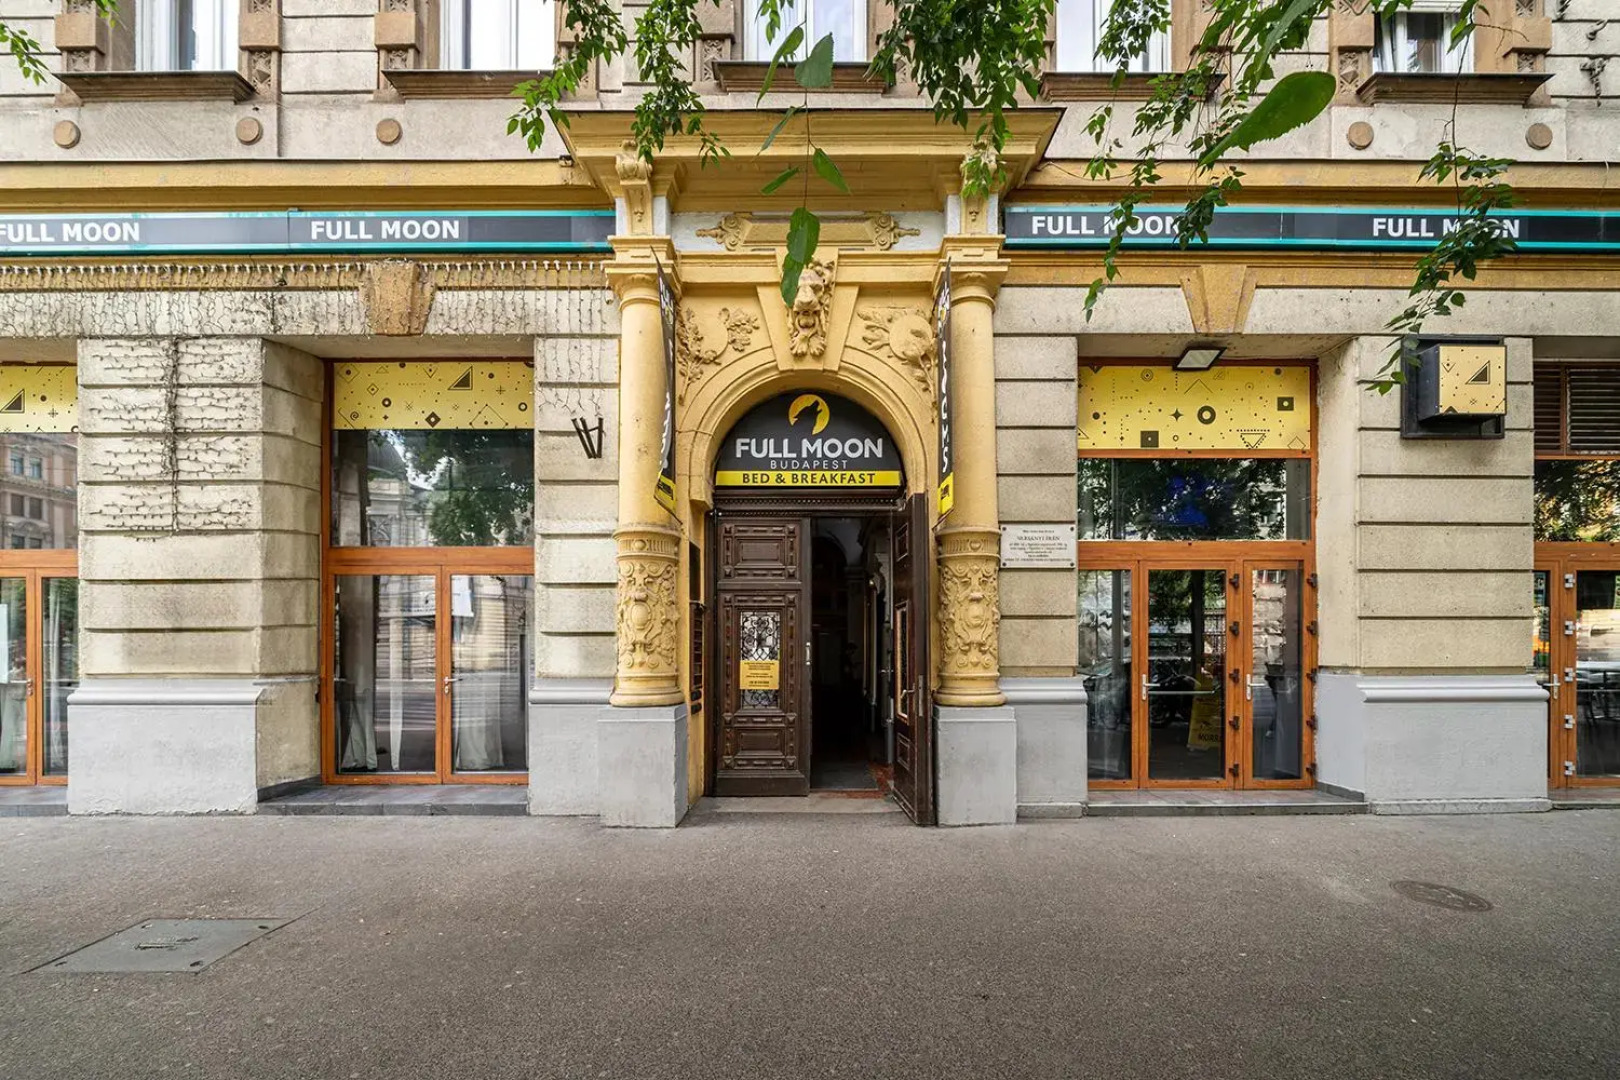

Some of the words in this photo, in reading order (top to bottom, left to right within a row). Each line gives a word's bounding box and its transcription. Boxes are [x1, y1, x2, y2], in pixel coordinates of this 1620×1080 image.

[62, 222, 140, 242] MOON
[311, 221, 373, 240] FULL
[381, 220, 459, 239] MOON
[1032, 215, 1095, 235] FULL
[1373, 218, 1434, 237] FULL
[1442, 218, 1520, 239] MN
[736, 438, 797, 458] FULL
[801, 438, 883, 458] MOON
[770, 459, 848, 470] BUDAPEST
[742, 473, 770, 484] BED
[775, 473, 786, 484] &
[791, 473, 876, 484] BREAKFAST
